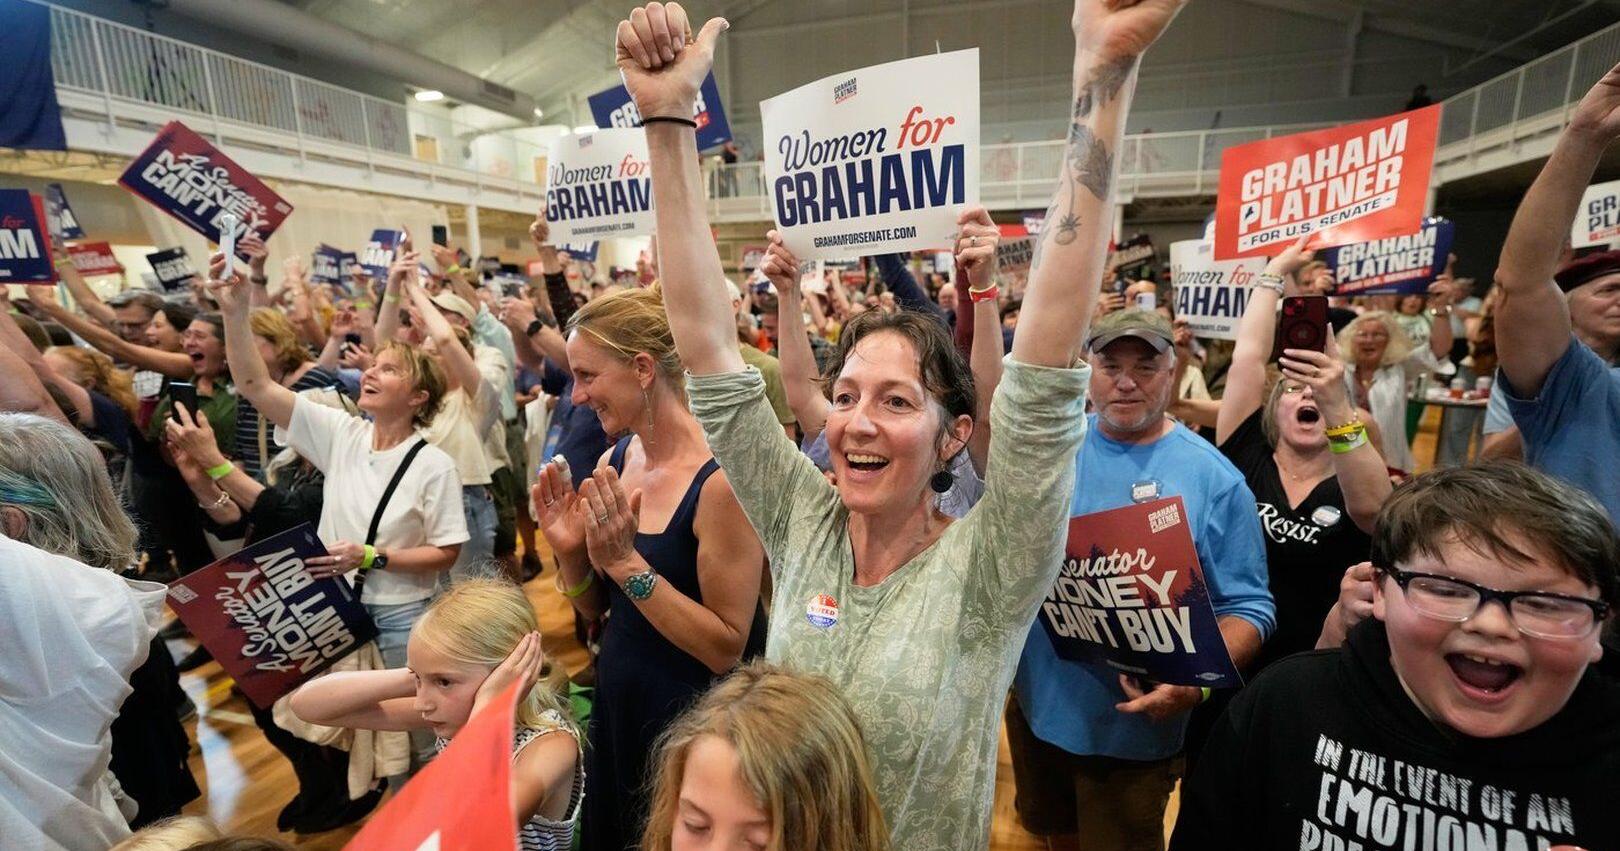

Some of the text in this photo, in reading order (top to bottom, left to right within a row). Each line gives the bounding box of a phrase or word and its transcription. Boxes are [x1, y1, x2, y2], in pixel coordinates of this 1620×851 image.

[618, 154, 650, 177] for
[778, 105, 955, 172] Women for
[1241, 118, 1409, 202] GRAHAM
[155, 149, 270, 229] MONEY
[774, 143, 965, 228] GRAHAM
[1238, 154, 1403, 235] PLATNER
[1251, 197, 1381, 246] FOR U.S. SENATE
[813, 226, 917, 248] GRAHAMFORSENATE.COM
[1336, 247, 1435, 284] PLATNER
[1337, 226, 1437, 265] GRAHAM
[1228, 264, 1255, 285] for
[1256, 502, 1321, 544] Resist.
[214, 586, 296, 673] A Senator
[225, 567, 326, 675] MONEY
[253, 547, 356, 658] CAN'T BUY
[1042, 601, 1197, 654] CAN'T BUY
[1314, 733, 1576, 836] IN THE EVENT OF AN
[1316, 771, 1551, 851] EMOTION
